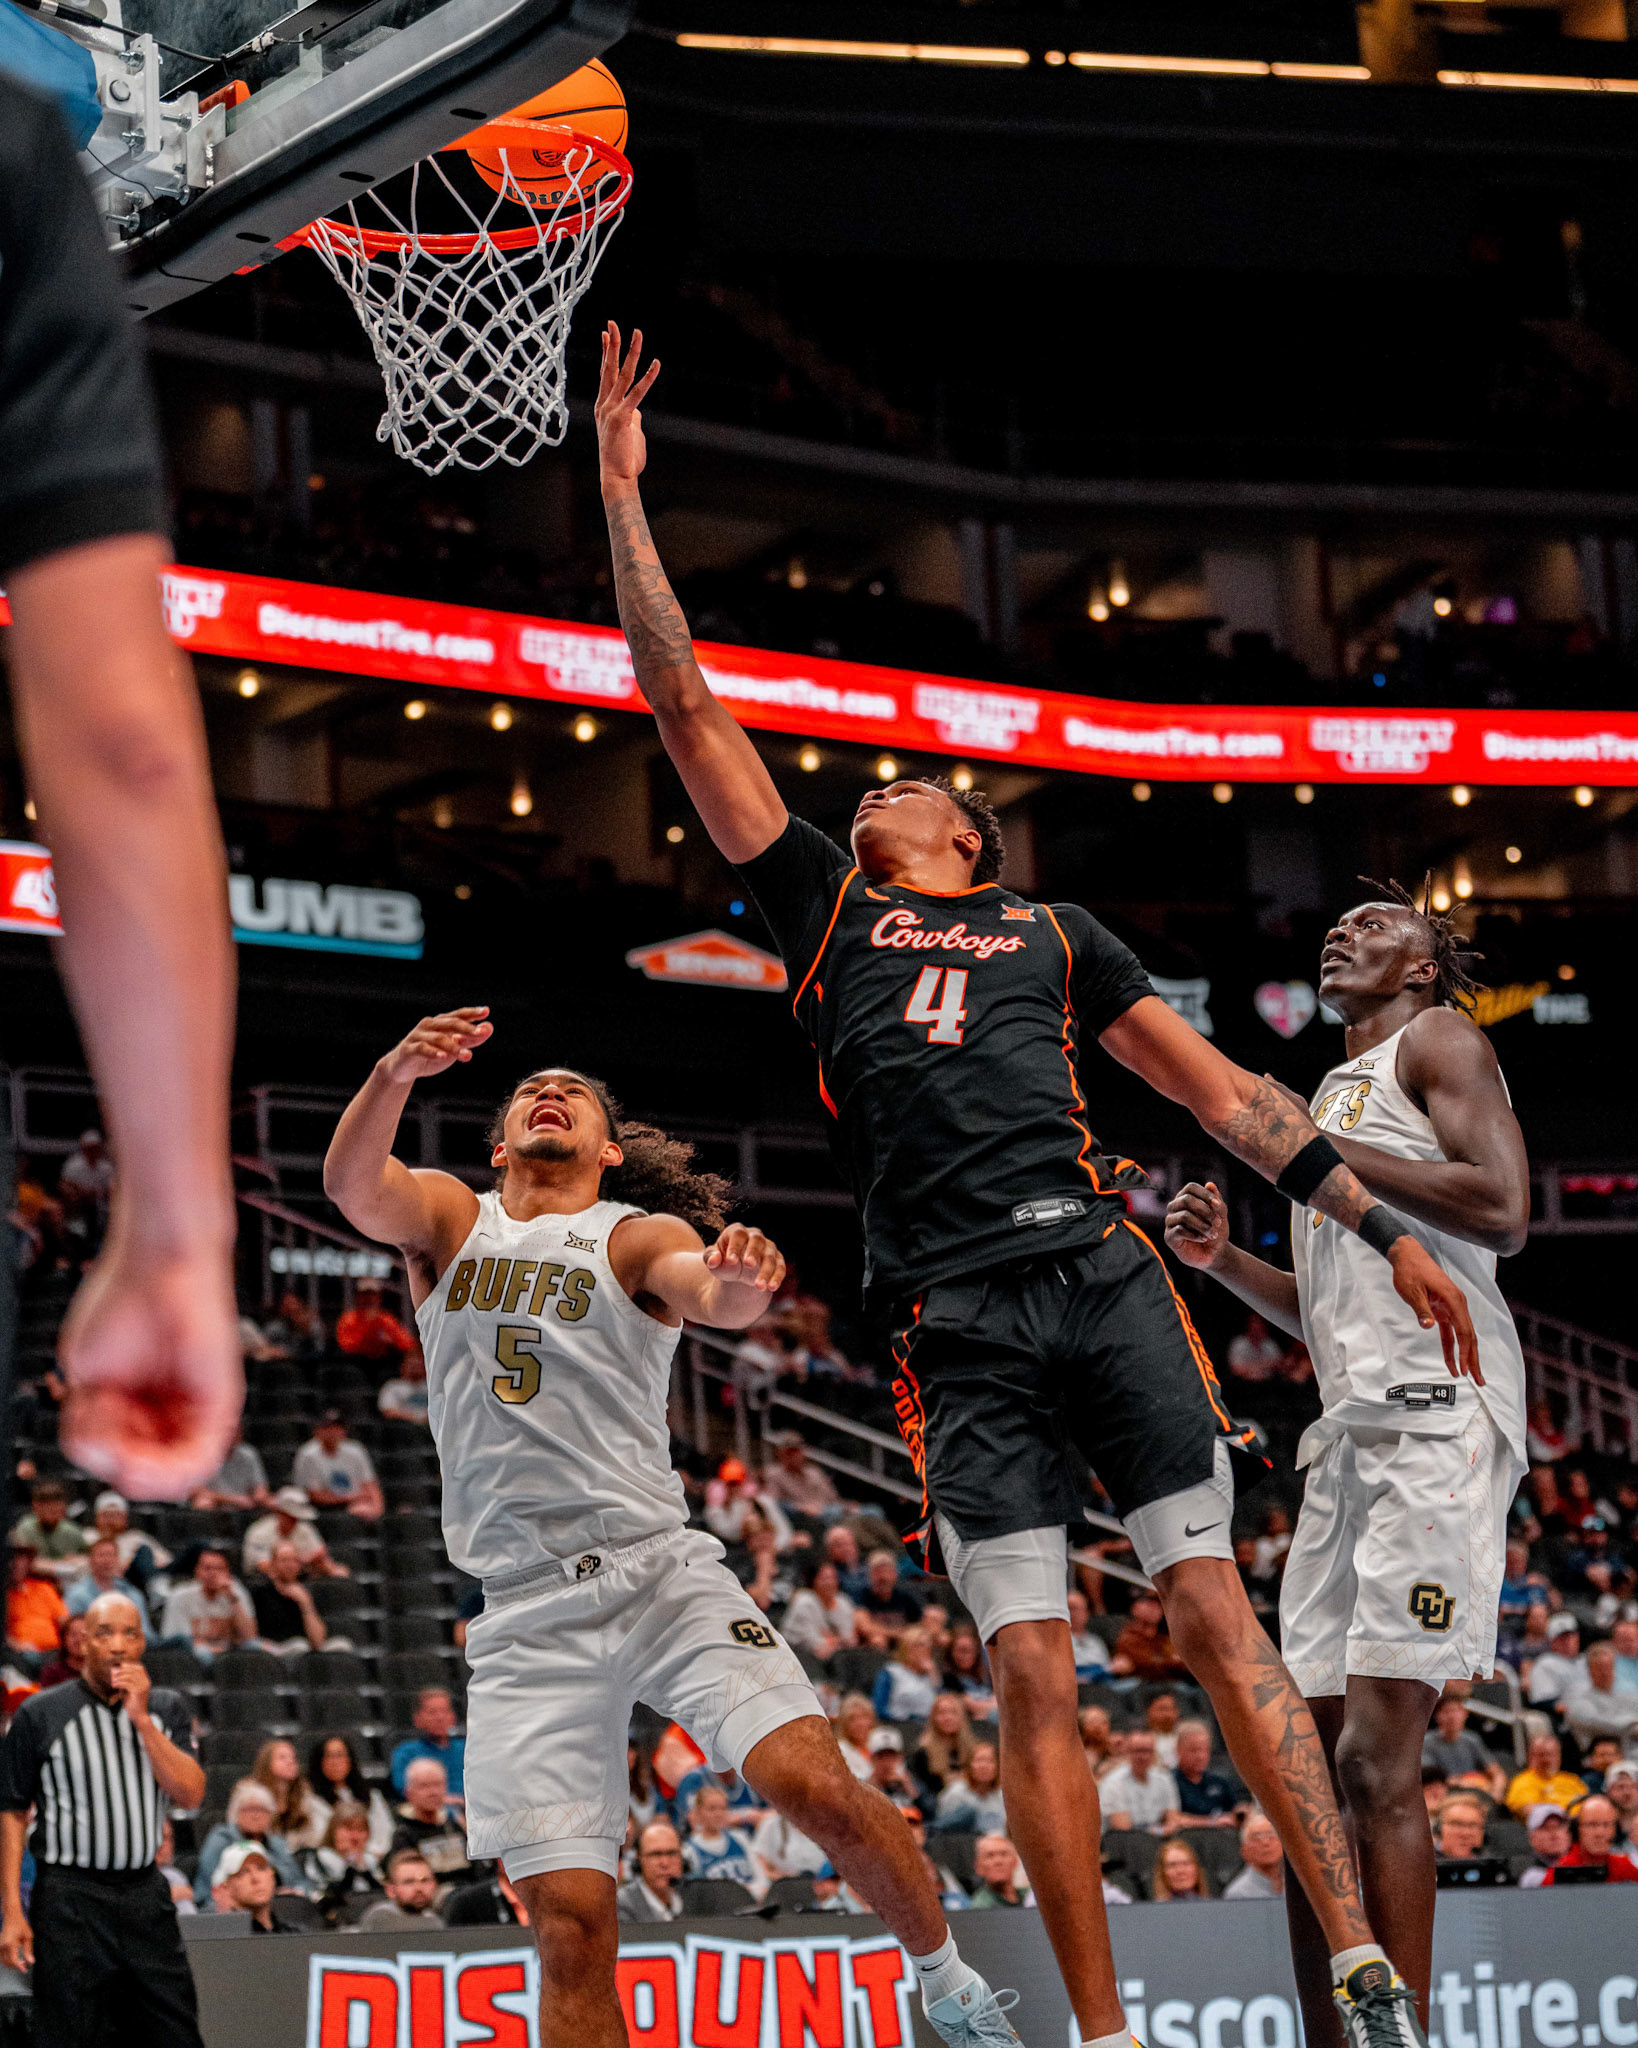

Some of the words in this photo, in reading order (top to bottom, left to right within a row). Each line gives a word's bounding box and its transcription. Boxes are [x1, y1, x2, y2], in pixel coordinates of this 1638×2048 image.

[229, 874, 425, 943] UMB
[870, 908, 1027, 960] Cowboys
[904, 965, 969, 1045] 4
[445, 1257, 596, 1322] BUFFS
[491, 1325, 542, 1405] 5
[1435, 1389, 1447, 1398] 48
[728, 1617, 779, 1649] CU
[1408, 1582, 1456, 1633] CU
[309, 1935, 917, 2048] DISOUNT
